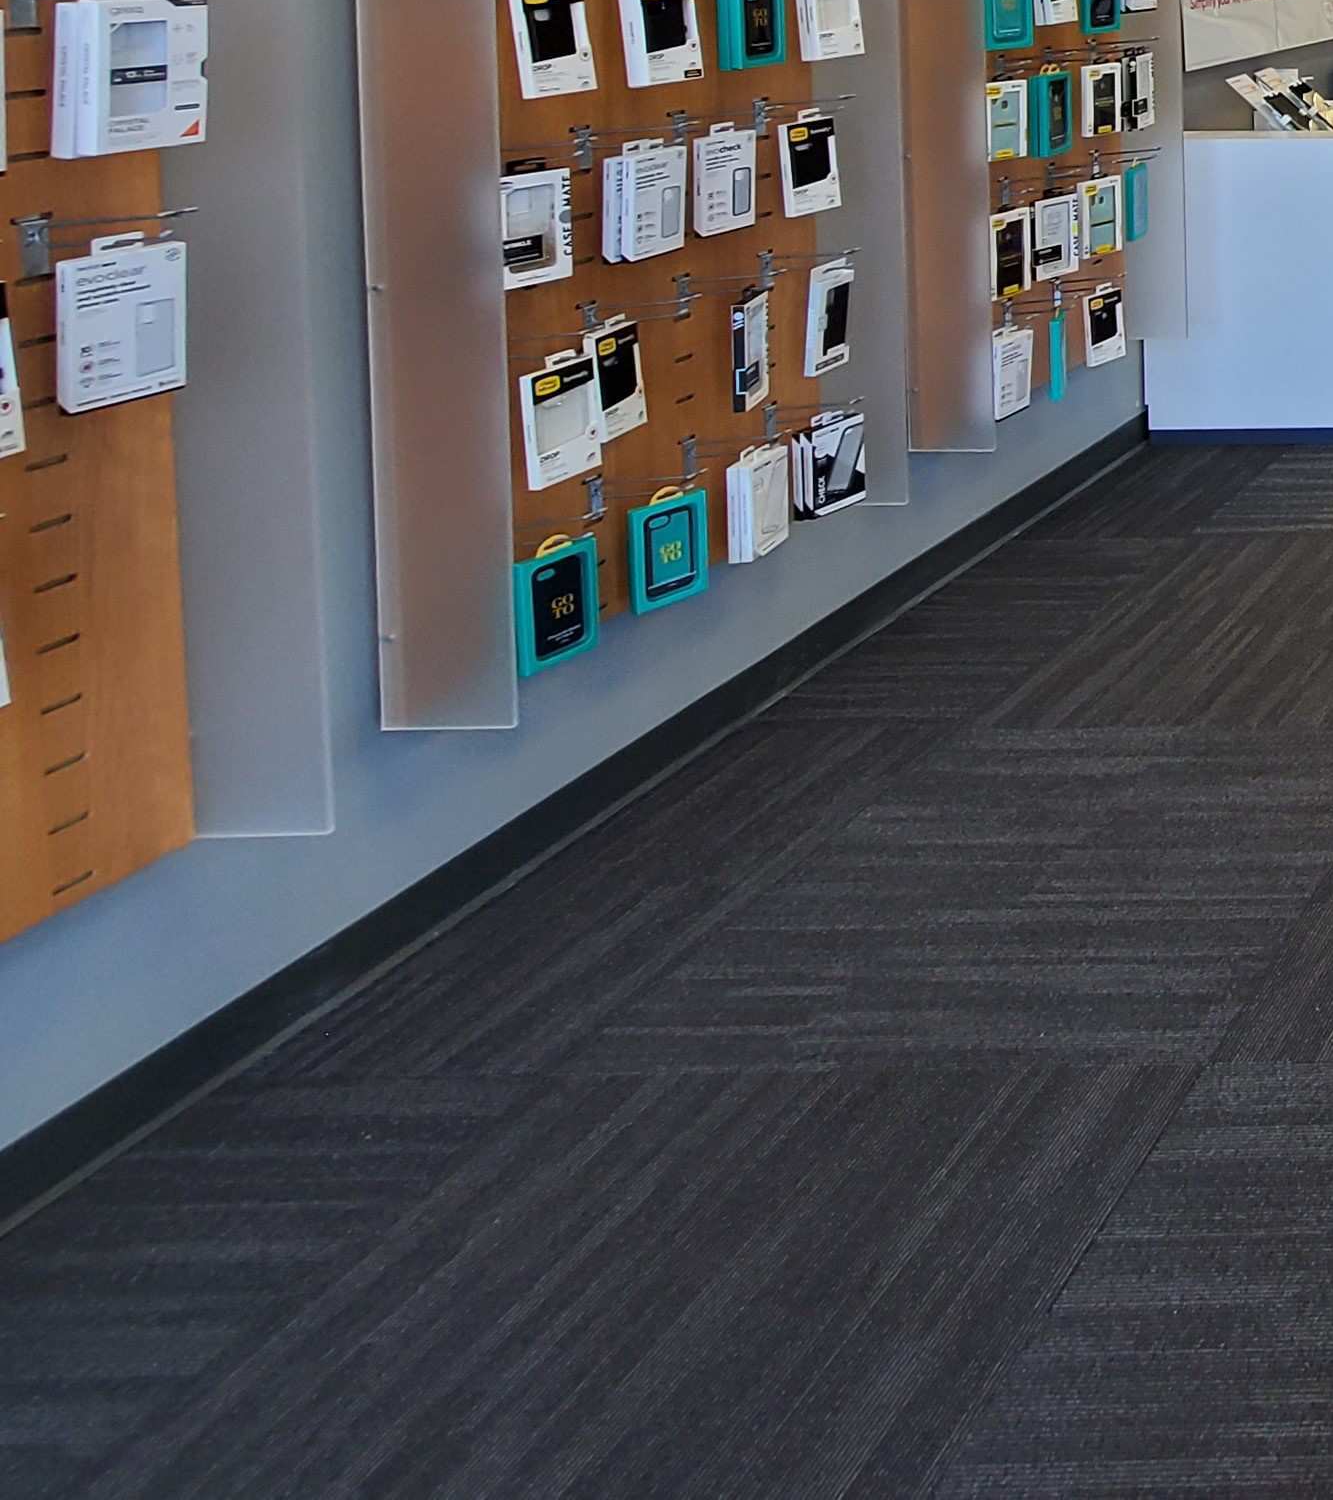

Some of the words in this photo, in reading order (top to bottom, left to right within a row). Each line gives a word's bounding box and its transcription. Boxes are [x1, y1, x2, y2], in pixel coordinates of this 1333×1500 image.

[560, 175, 572, 208] MATE
[562, 226, 573, 257] CASE
[75, 264, 148, 287] evoclear
[818, 475, 827, 505] CHECK
[551, 592, 575, 608] GO
[552, 604, 575, 620] TO
